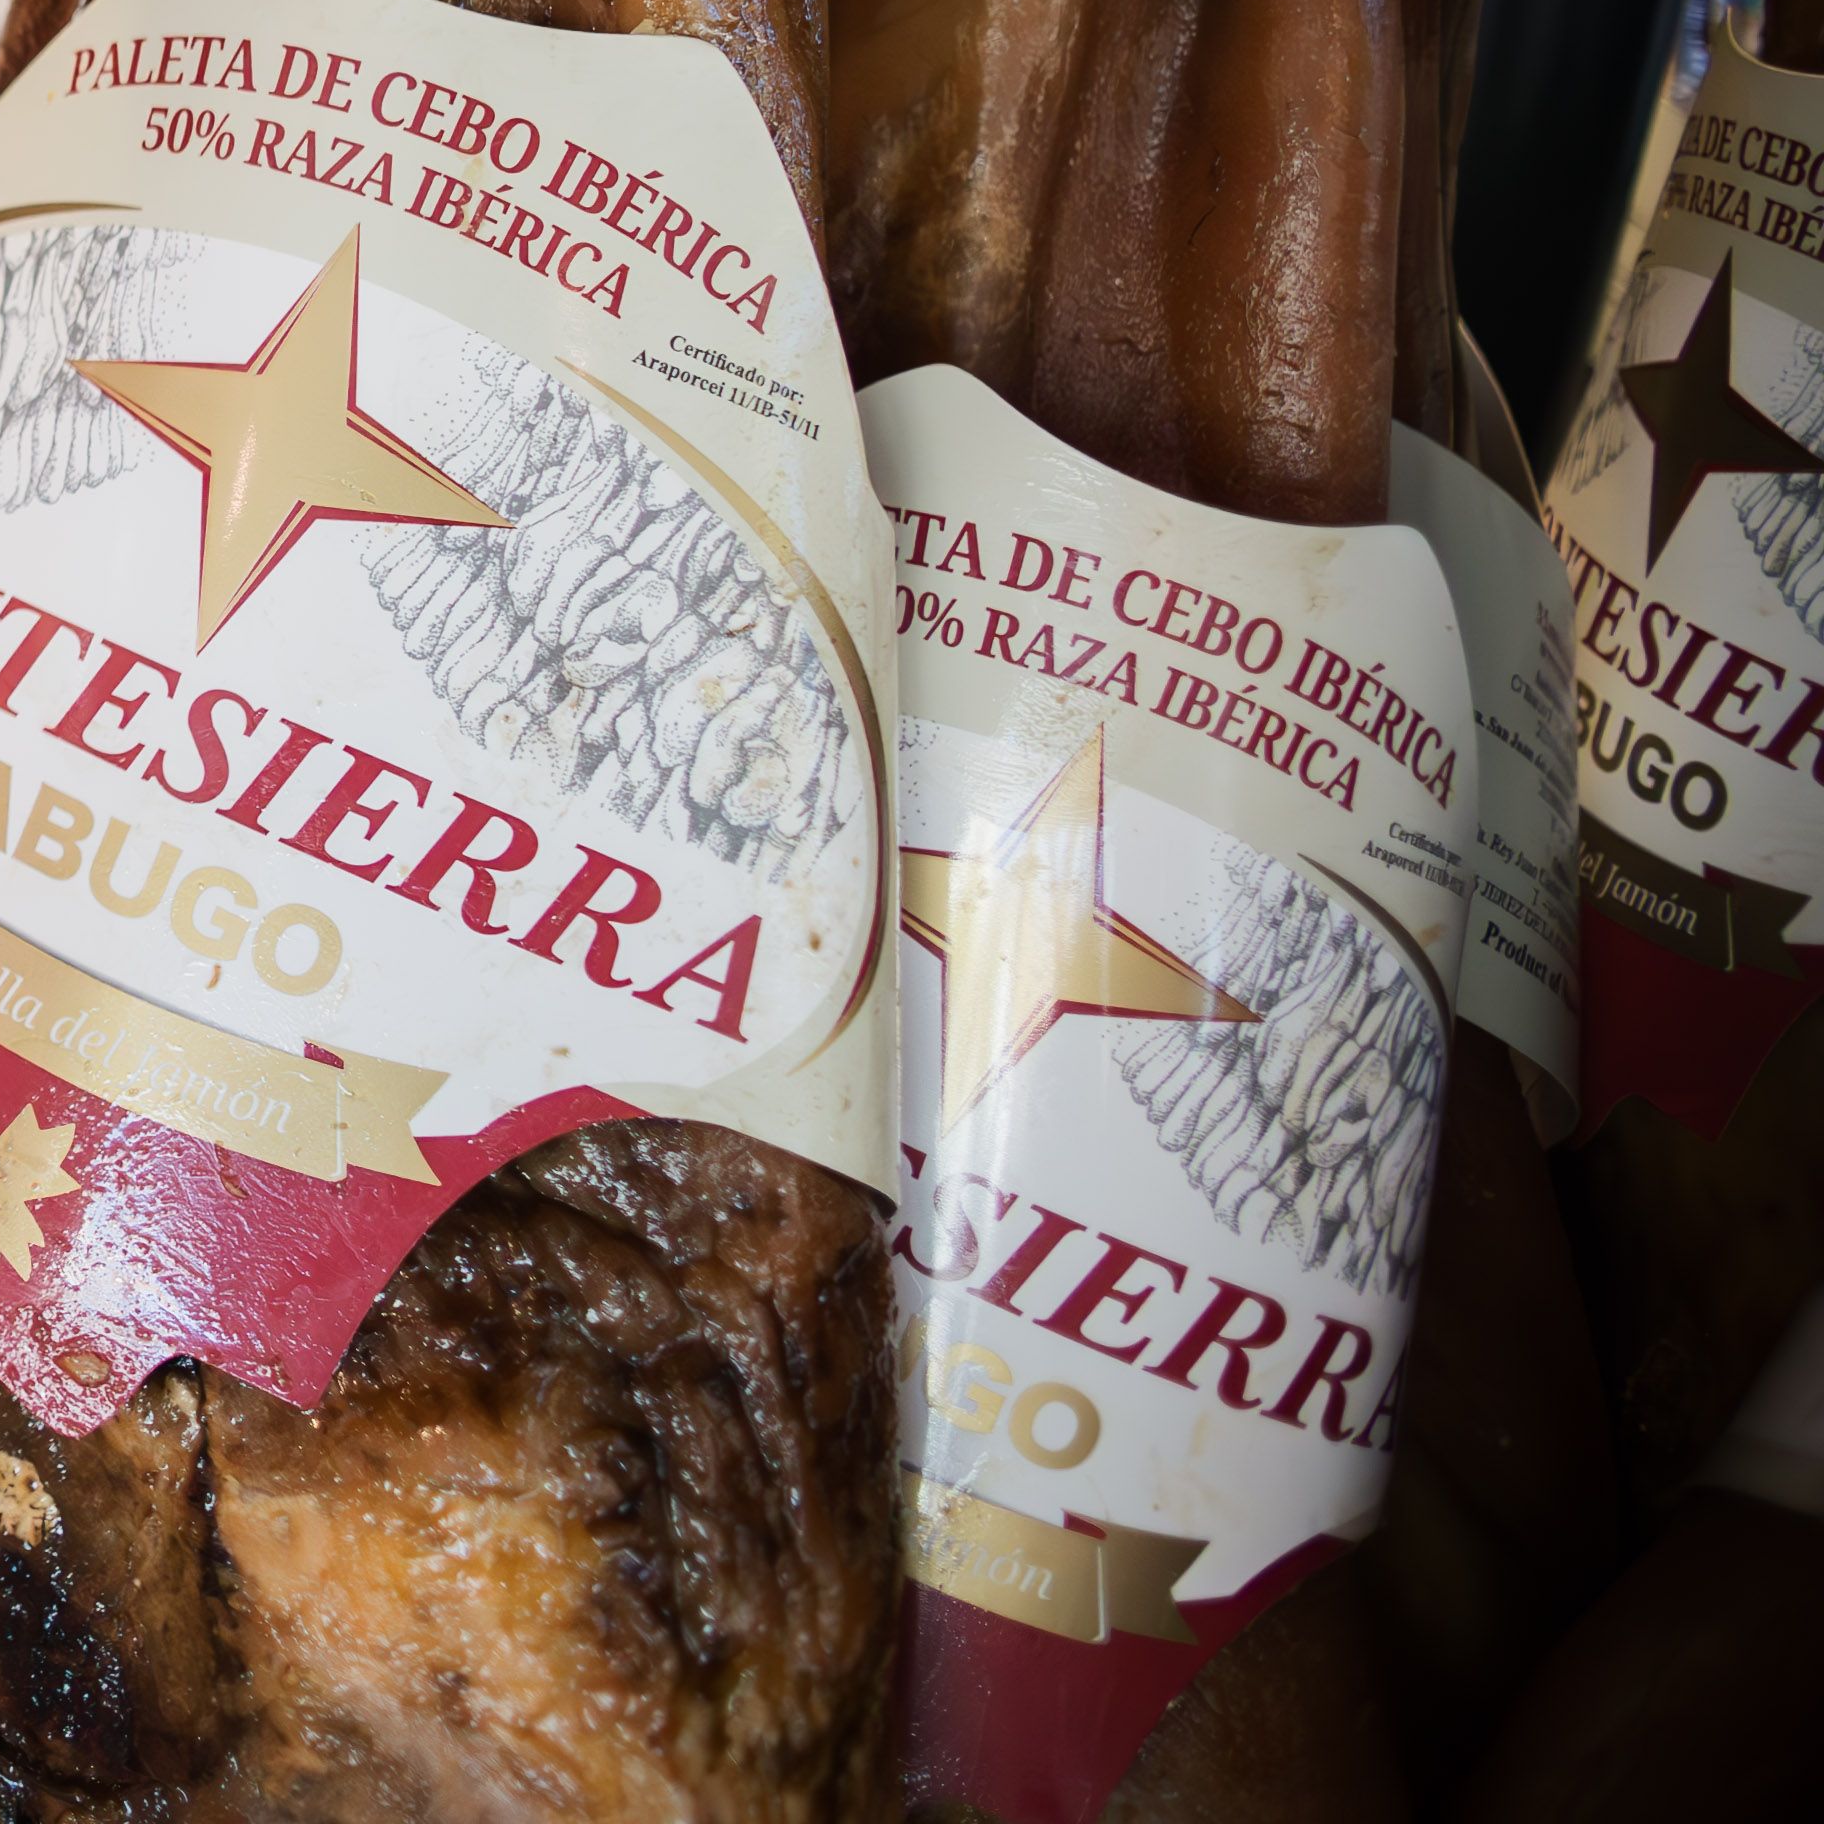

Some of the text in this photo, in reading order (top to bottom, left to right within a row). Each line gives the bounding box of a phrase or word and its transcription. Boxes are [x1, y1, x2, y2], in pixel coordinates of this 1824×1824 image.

[65, 36, 780, 335] PALETA DE CEBO IBÉRICA
[140, 106, 632, 320] 50% RAZA IBÉRICA
[1688, 174, 1750, 232] RAZA
[631, 349, 726, 398] Araporcei
[669, 334, 805, 406] Certificado por:
[974, 606, 1138, 706] RAZA
[1149, 665, 1361, 814] IBÉRICA
[998, 532, 1102, 610] DE
[1112, 569, 1284, 675] CEBO
[1283, 637, 1457, 811] IBÉRICA
[1480, 919, 1549, 985] Product
[1598, 863, 1699, 936] Jamón
[49, 1011, 127, 1069] del
[116, 1042, 294, 1134] Jamón
[892, 1141, 1408, 1453] SIERRA
